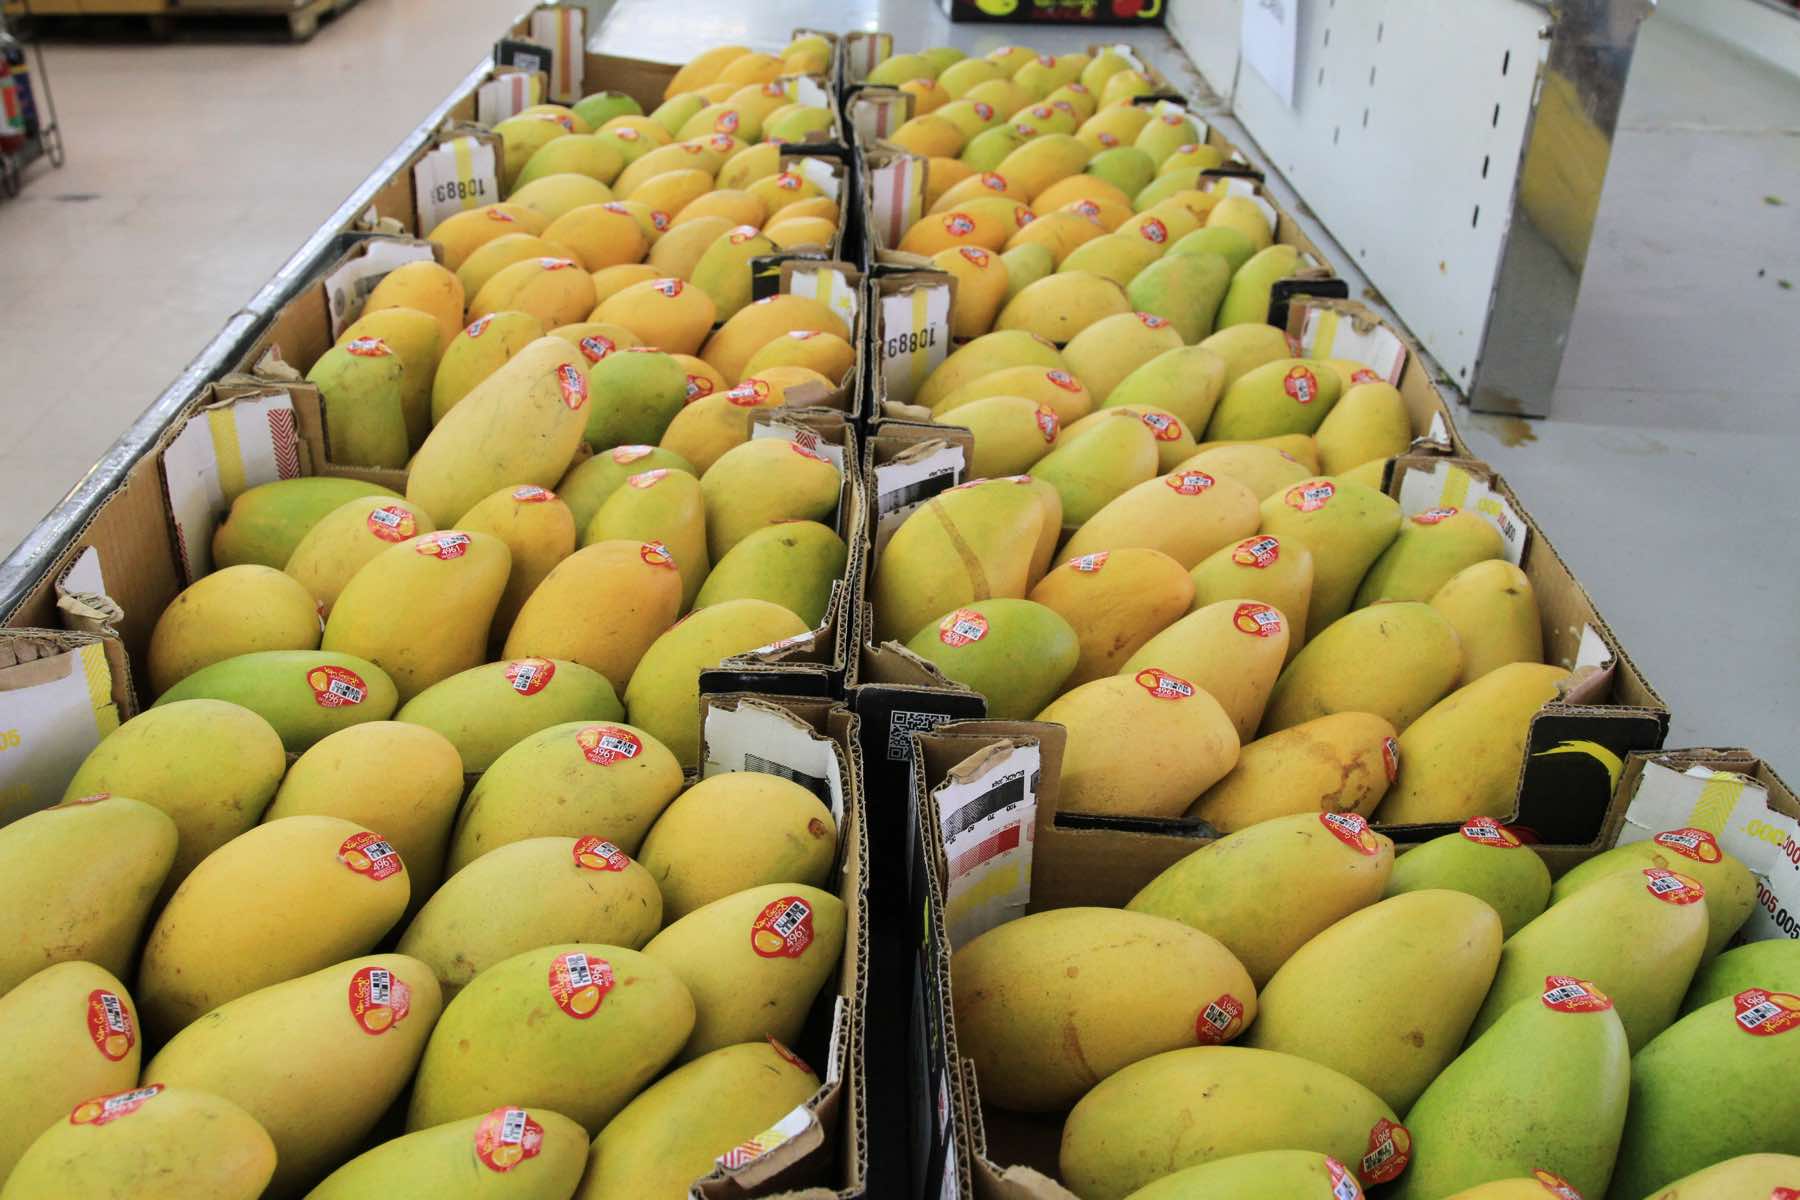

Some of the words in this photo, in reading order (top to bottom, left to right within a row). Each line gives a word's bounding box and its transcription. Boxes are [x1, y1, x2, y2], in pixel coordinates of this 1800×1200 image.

[888, 327, 937, 358] 10889
[441, 544, 459, 554] 4961
[322, 691, 344, 704] 4961
[591, 745, 615, 760] 4961
[372, 856, 392, 871] 4961
[785, 925, 805, 945] 4961
[1743, 993, 1766, 1008] 4961
